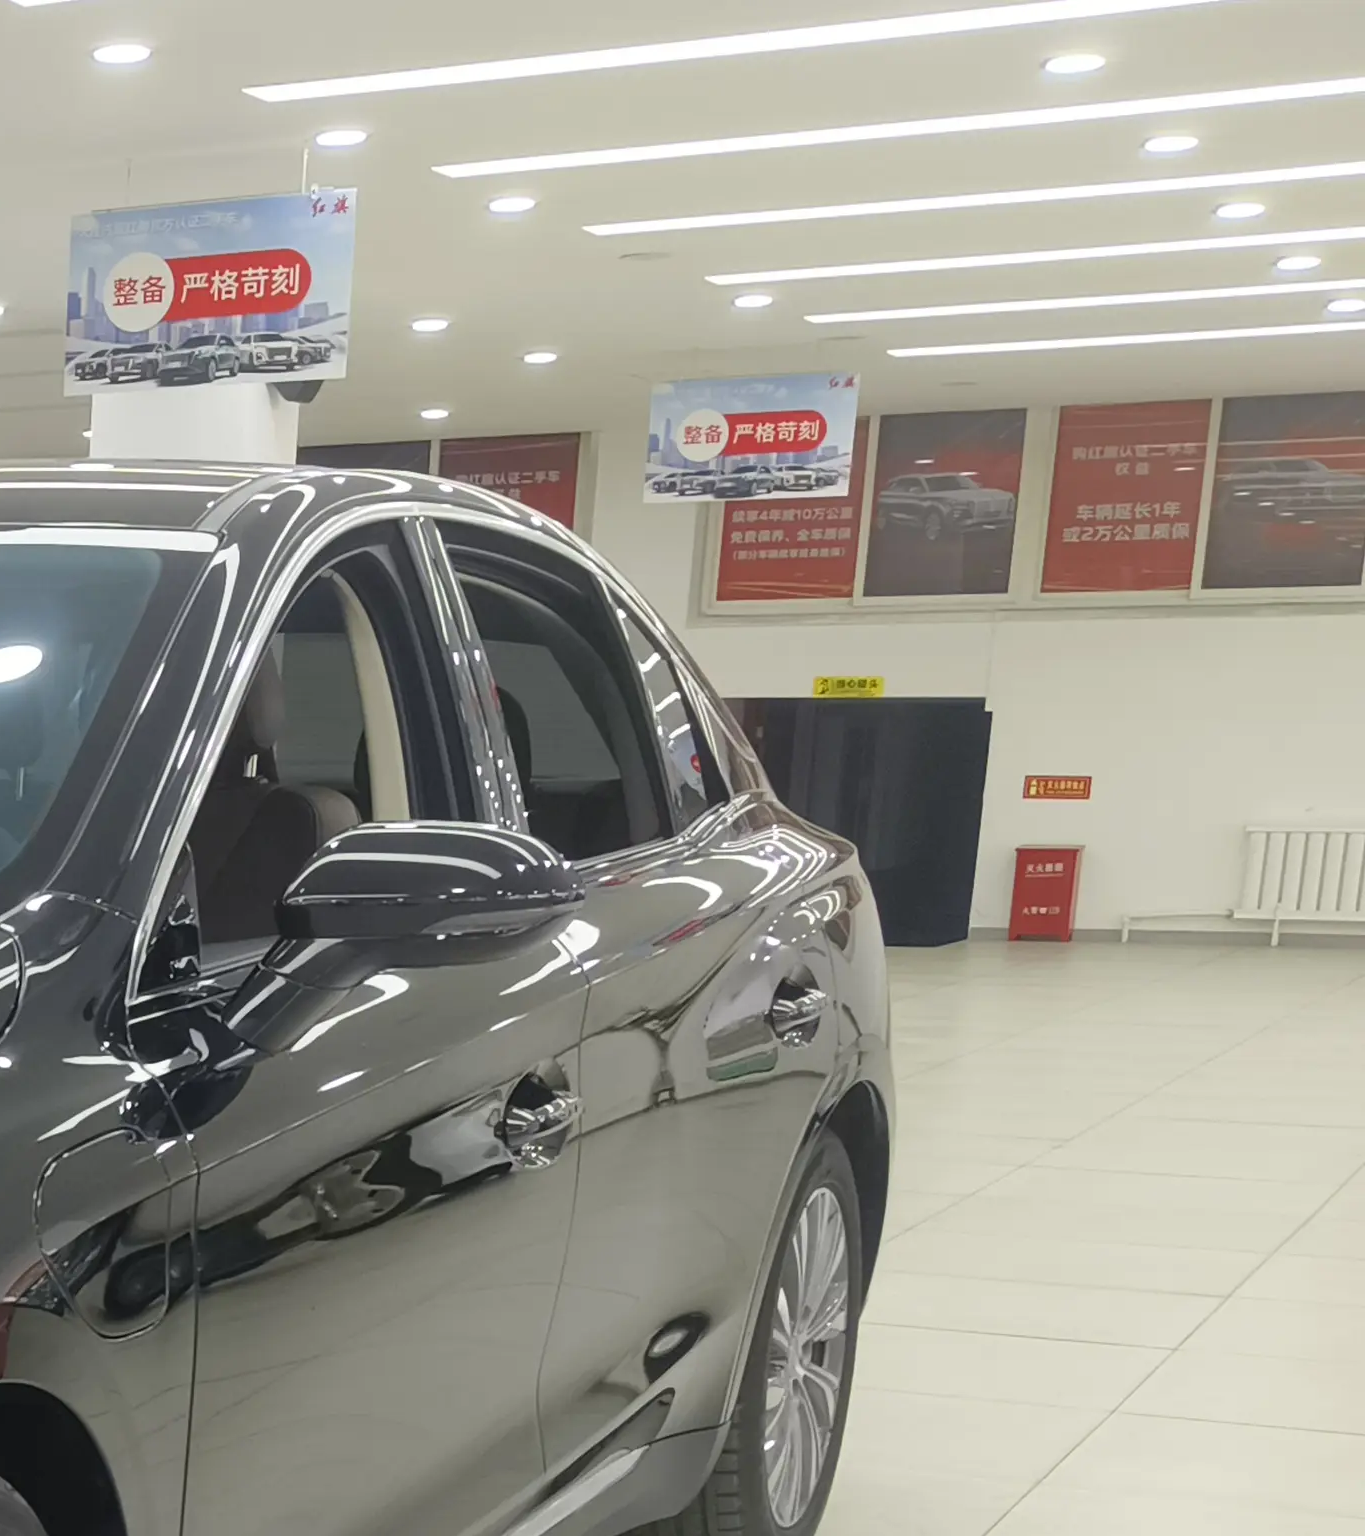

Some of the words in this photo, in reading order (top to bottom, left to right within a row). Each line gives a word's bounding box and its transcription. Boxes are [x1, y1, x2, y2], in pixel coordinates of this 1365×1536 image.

[112, 275, 167, 306] 整备
[180, 263, 301, 304] 严格苛刻
[683, 424, 723, 445] 整备
[733, 418, 820, 444] 严格苛刻
[1076, 501, 1182, 521] 车辆延长1年
[1062, 522, 1190, 542] 或2万公里质保
